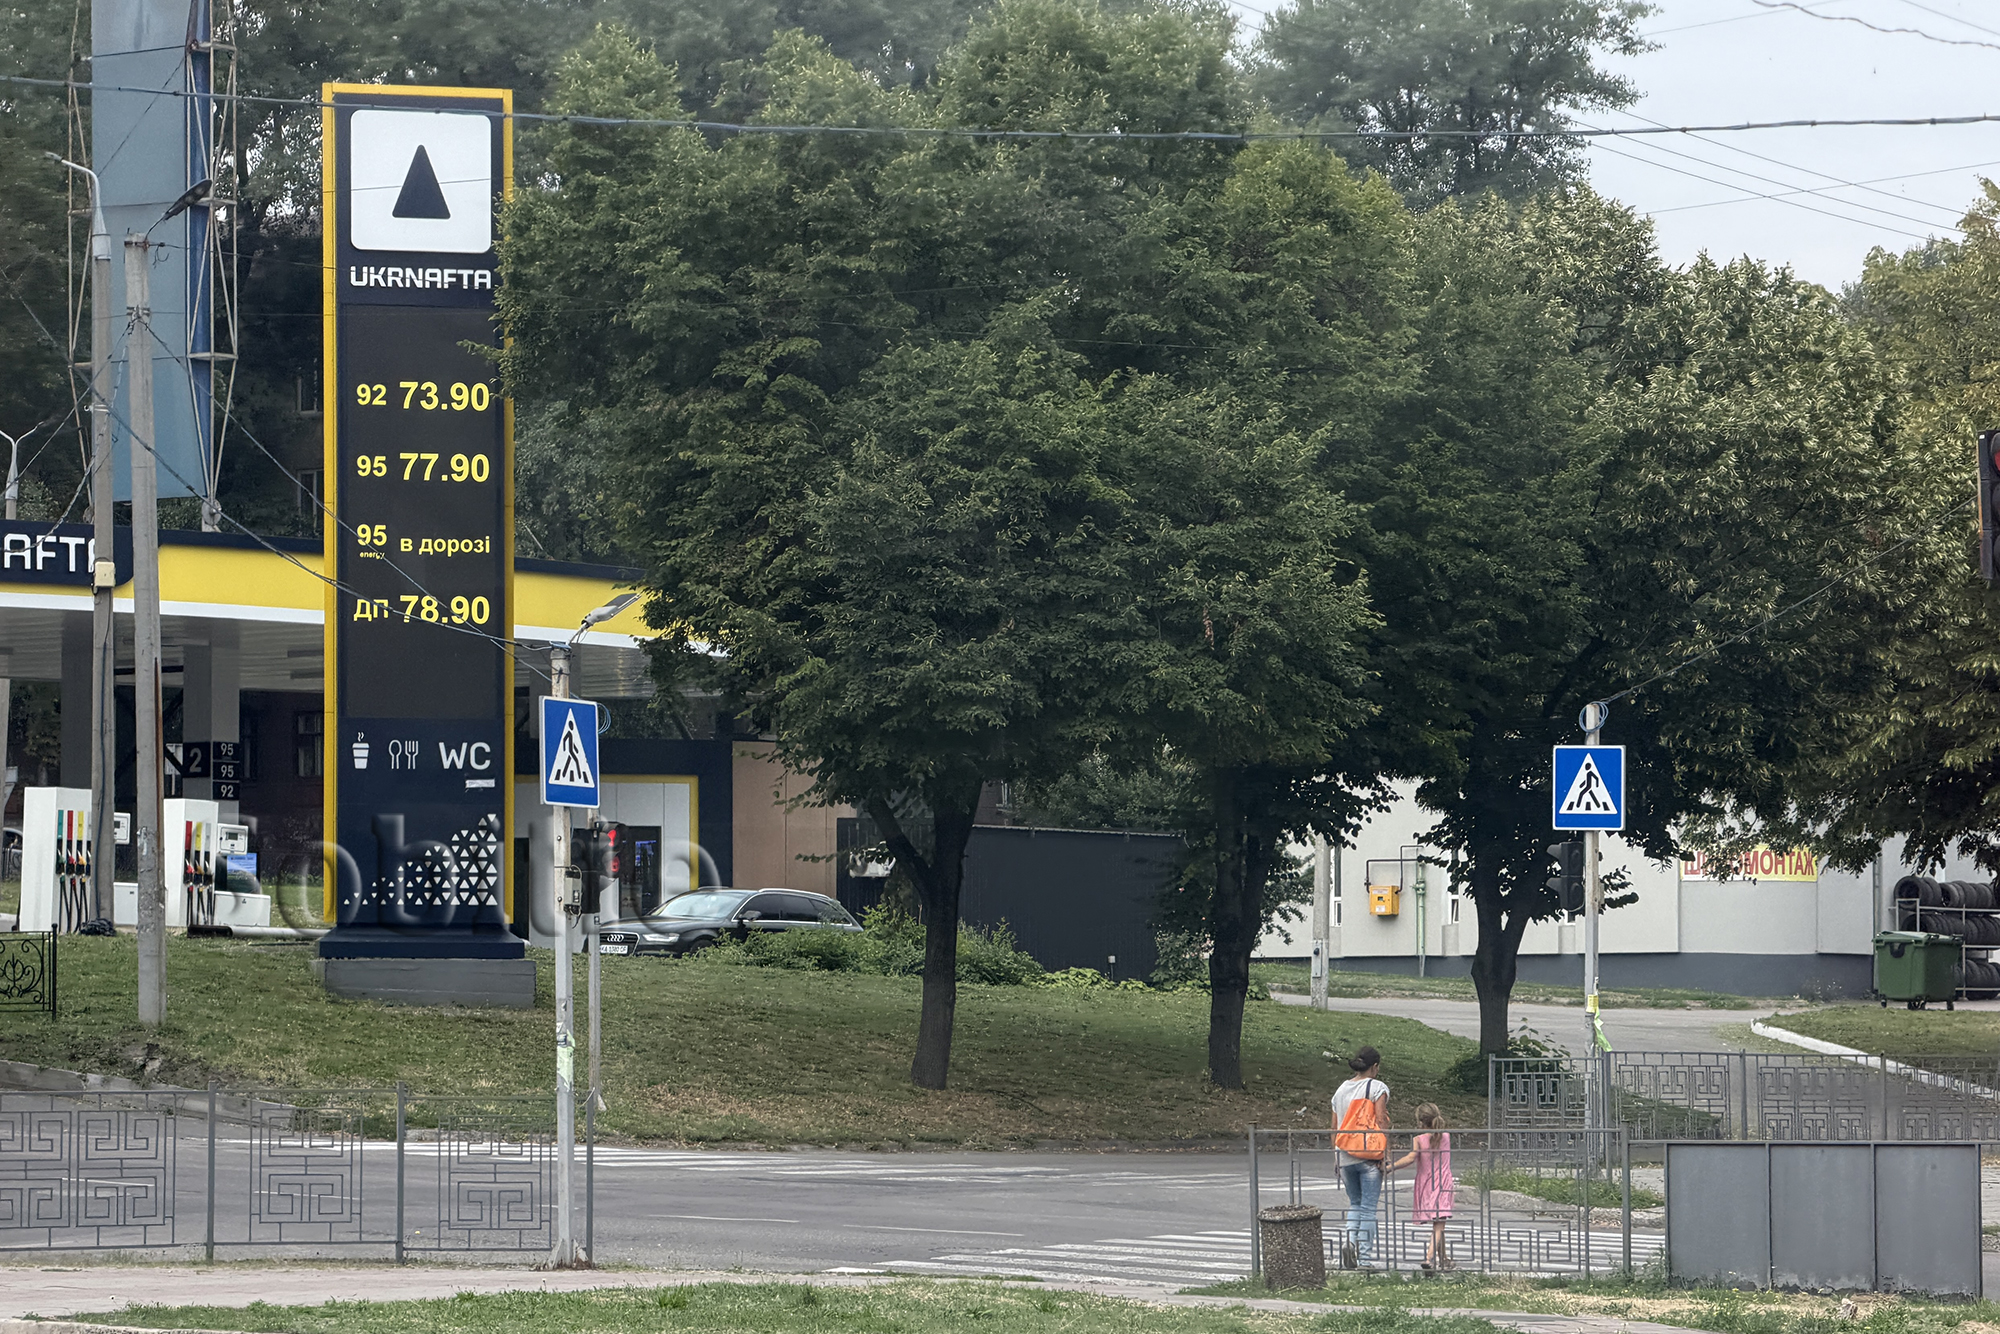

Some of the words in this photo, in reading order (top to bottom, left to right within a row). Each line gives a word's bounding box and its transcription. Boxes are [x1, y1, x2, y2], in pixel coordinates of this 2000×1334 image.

[350, 265, 491, 290] UKRNAFTA
[356, 383, 387, 406] 92
[399, 381, 490, 411] 73.90
[356, 455, 387, 477] 95
[399, 453, 490, 483] 77.90
[356, 523, 387, 547] 95
[400, 537, 413, 552] в
[418, 535, 490, 557] дорозі
[399, 594, 490, 625] 78.90
[189, 747, 202, 773] 2
[220, 742, 234, 756] 95
[438, 741, 491, 770] WC
[220, 764, 234, 778] 95
[220, 784, 234, 798] 92
